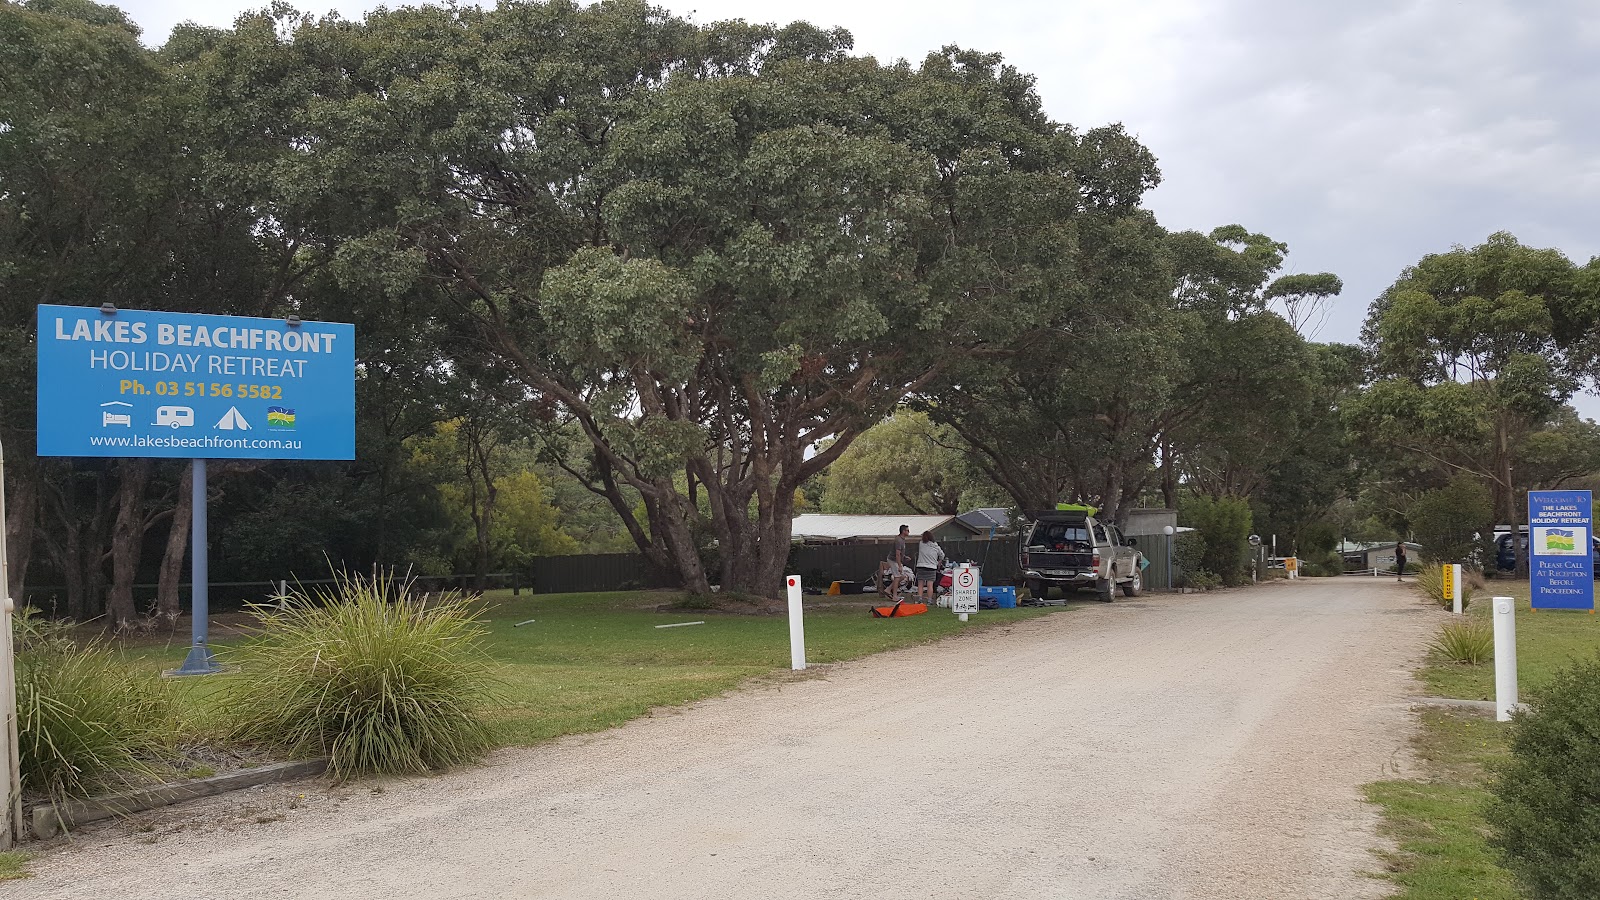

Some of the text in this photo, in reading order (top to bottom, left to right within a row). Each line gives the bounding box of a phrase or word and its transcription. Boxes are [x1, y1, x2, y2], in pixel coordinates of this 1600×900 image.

[55, 317, 337, 354] LAKES BEACHFRONT
[90, 349, 308, 378] HOLIDAY RETREAT
[120, 379, 151, 395] Ph.
[155, 381, 179, 396] 03
[237, 384, 283, 400] 5582
[89, 435, 302, 450] www.lakesbeachfront.com.au
[963, 575, 969, 584] 5
